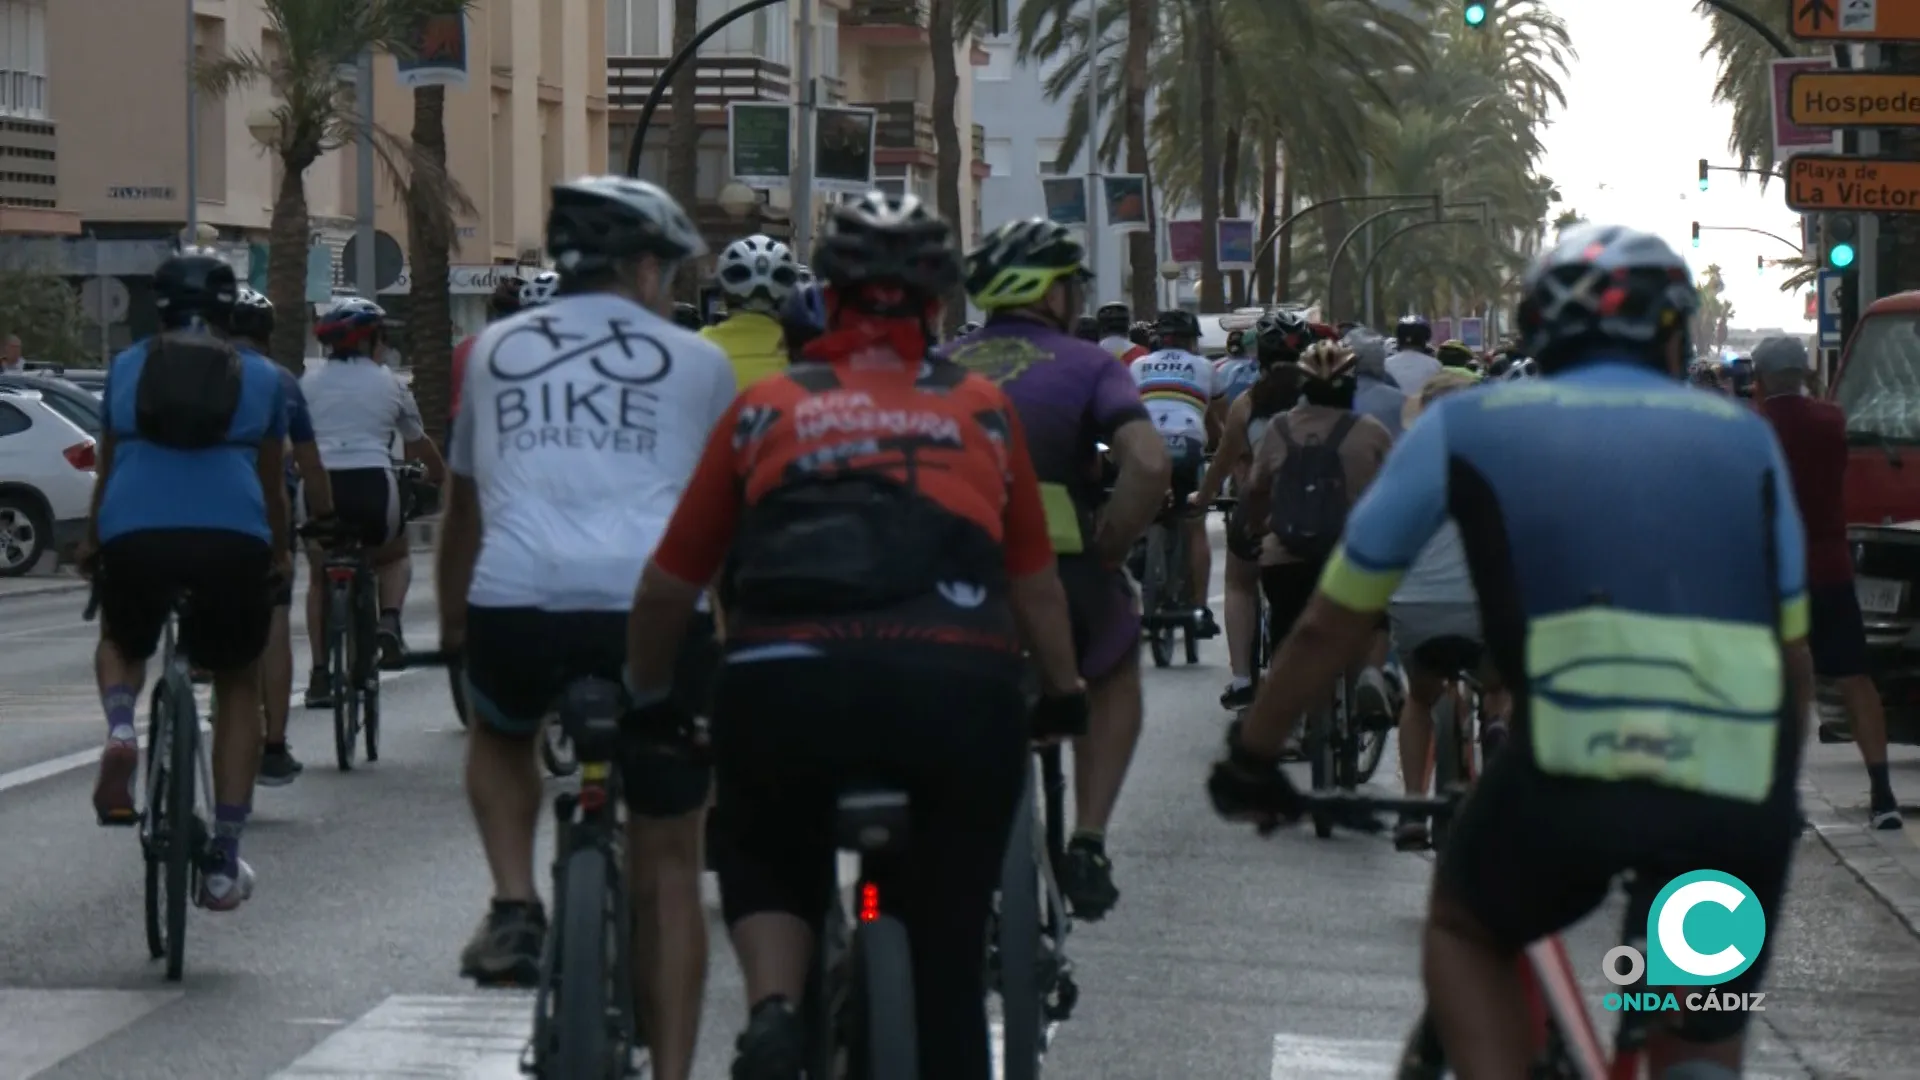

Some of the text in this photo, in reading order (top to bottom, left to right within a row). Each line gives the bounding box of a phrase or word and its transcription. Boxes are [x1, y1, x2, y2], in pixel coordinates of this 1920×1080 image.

[1796, 162, 1878, 182] Playa de
[1796, 182, 1920, 206] La Victor
[451, 267, 502, 288] Cadi
[496, 382, 660, 434] BIKE
[497, 427, 658, 457] FOREVER
